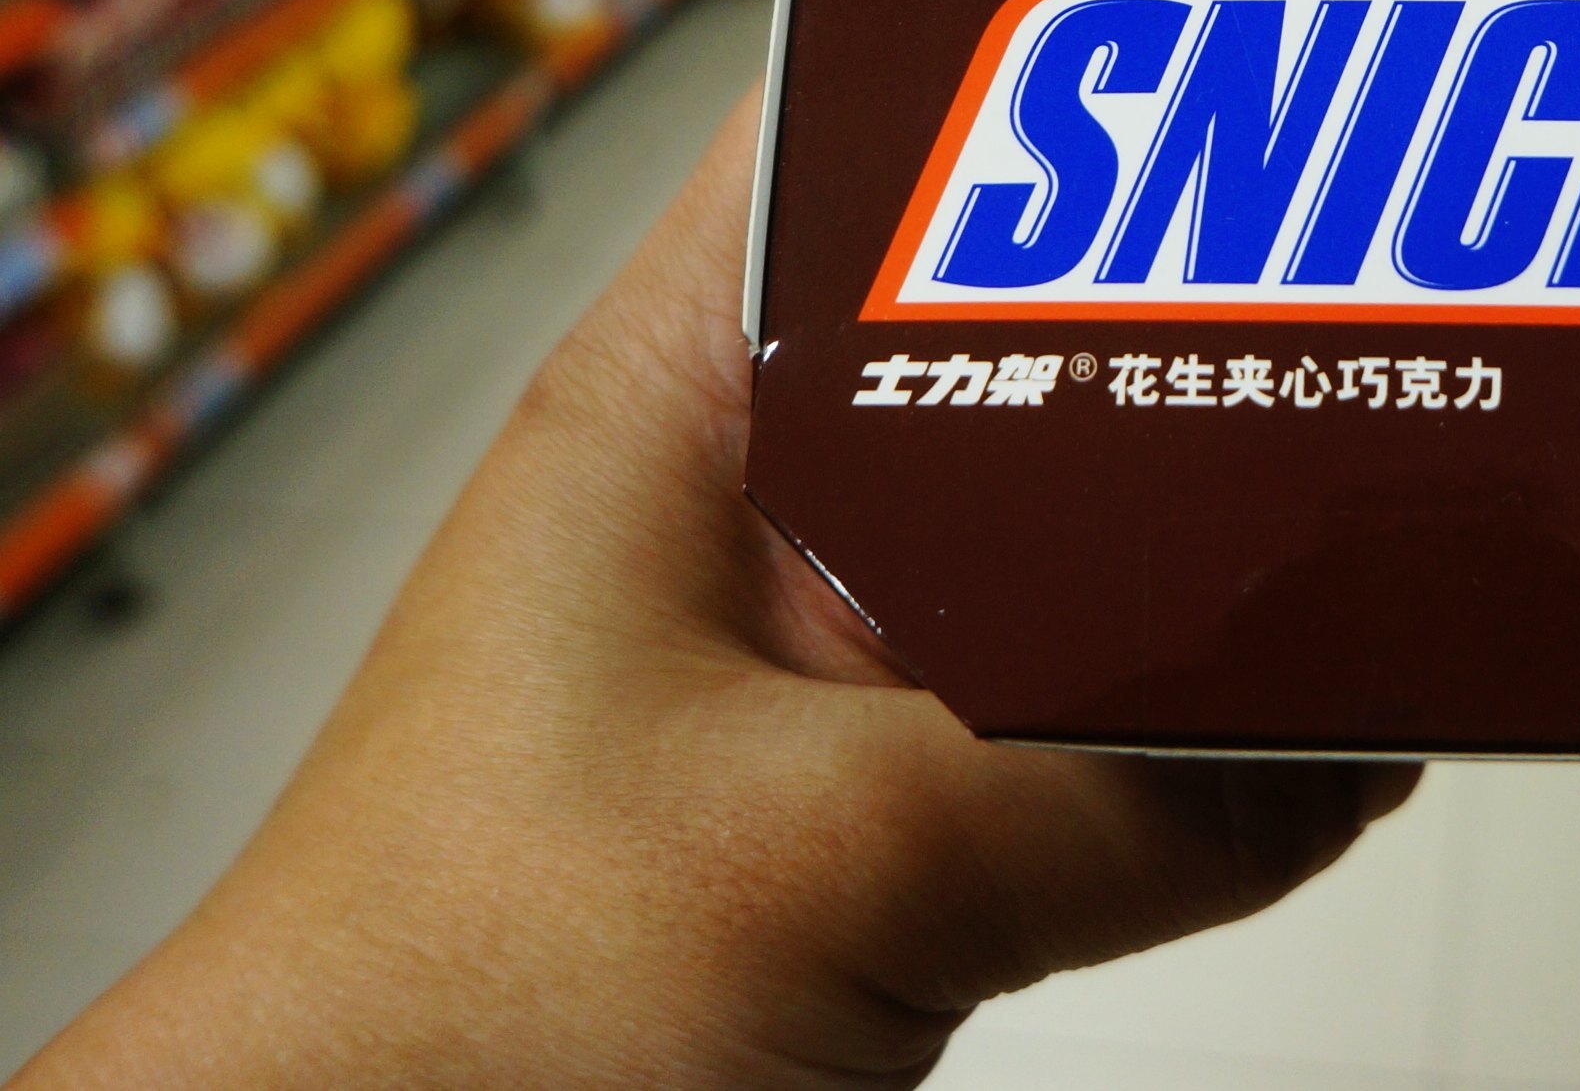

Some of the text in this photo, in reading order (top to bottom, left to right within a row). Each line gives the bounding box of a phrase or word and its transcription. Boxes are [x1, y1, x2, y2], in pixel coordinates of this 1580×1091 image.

[852, 354, 1503, 410] 士力架 花生夹心巧克力
